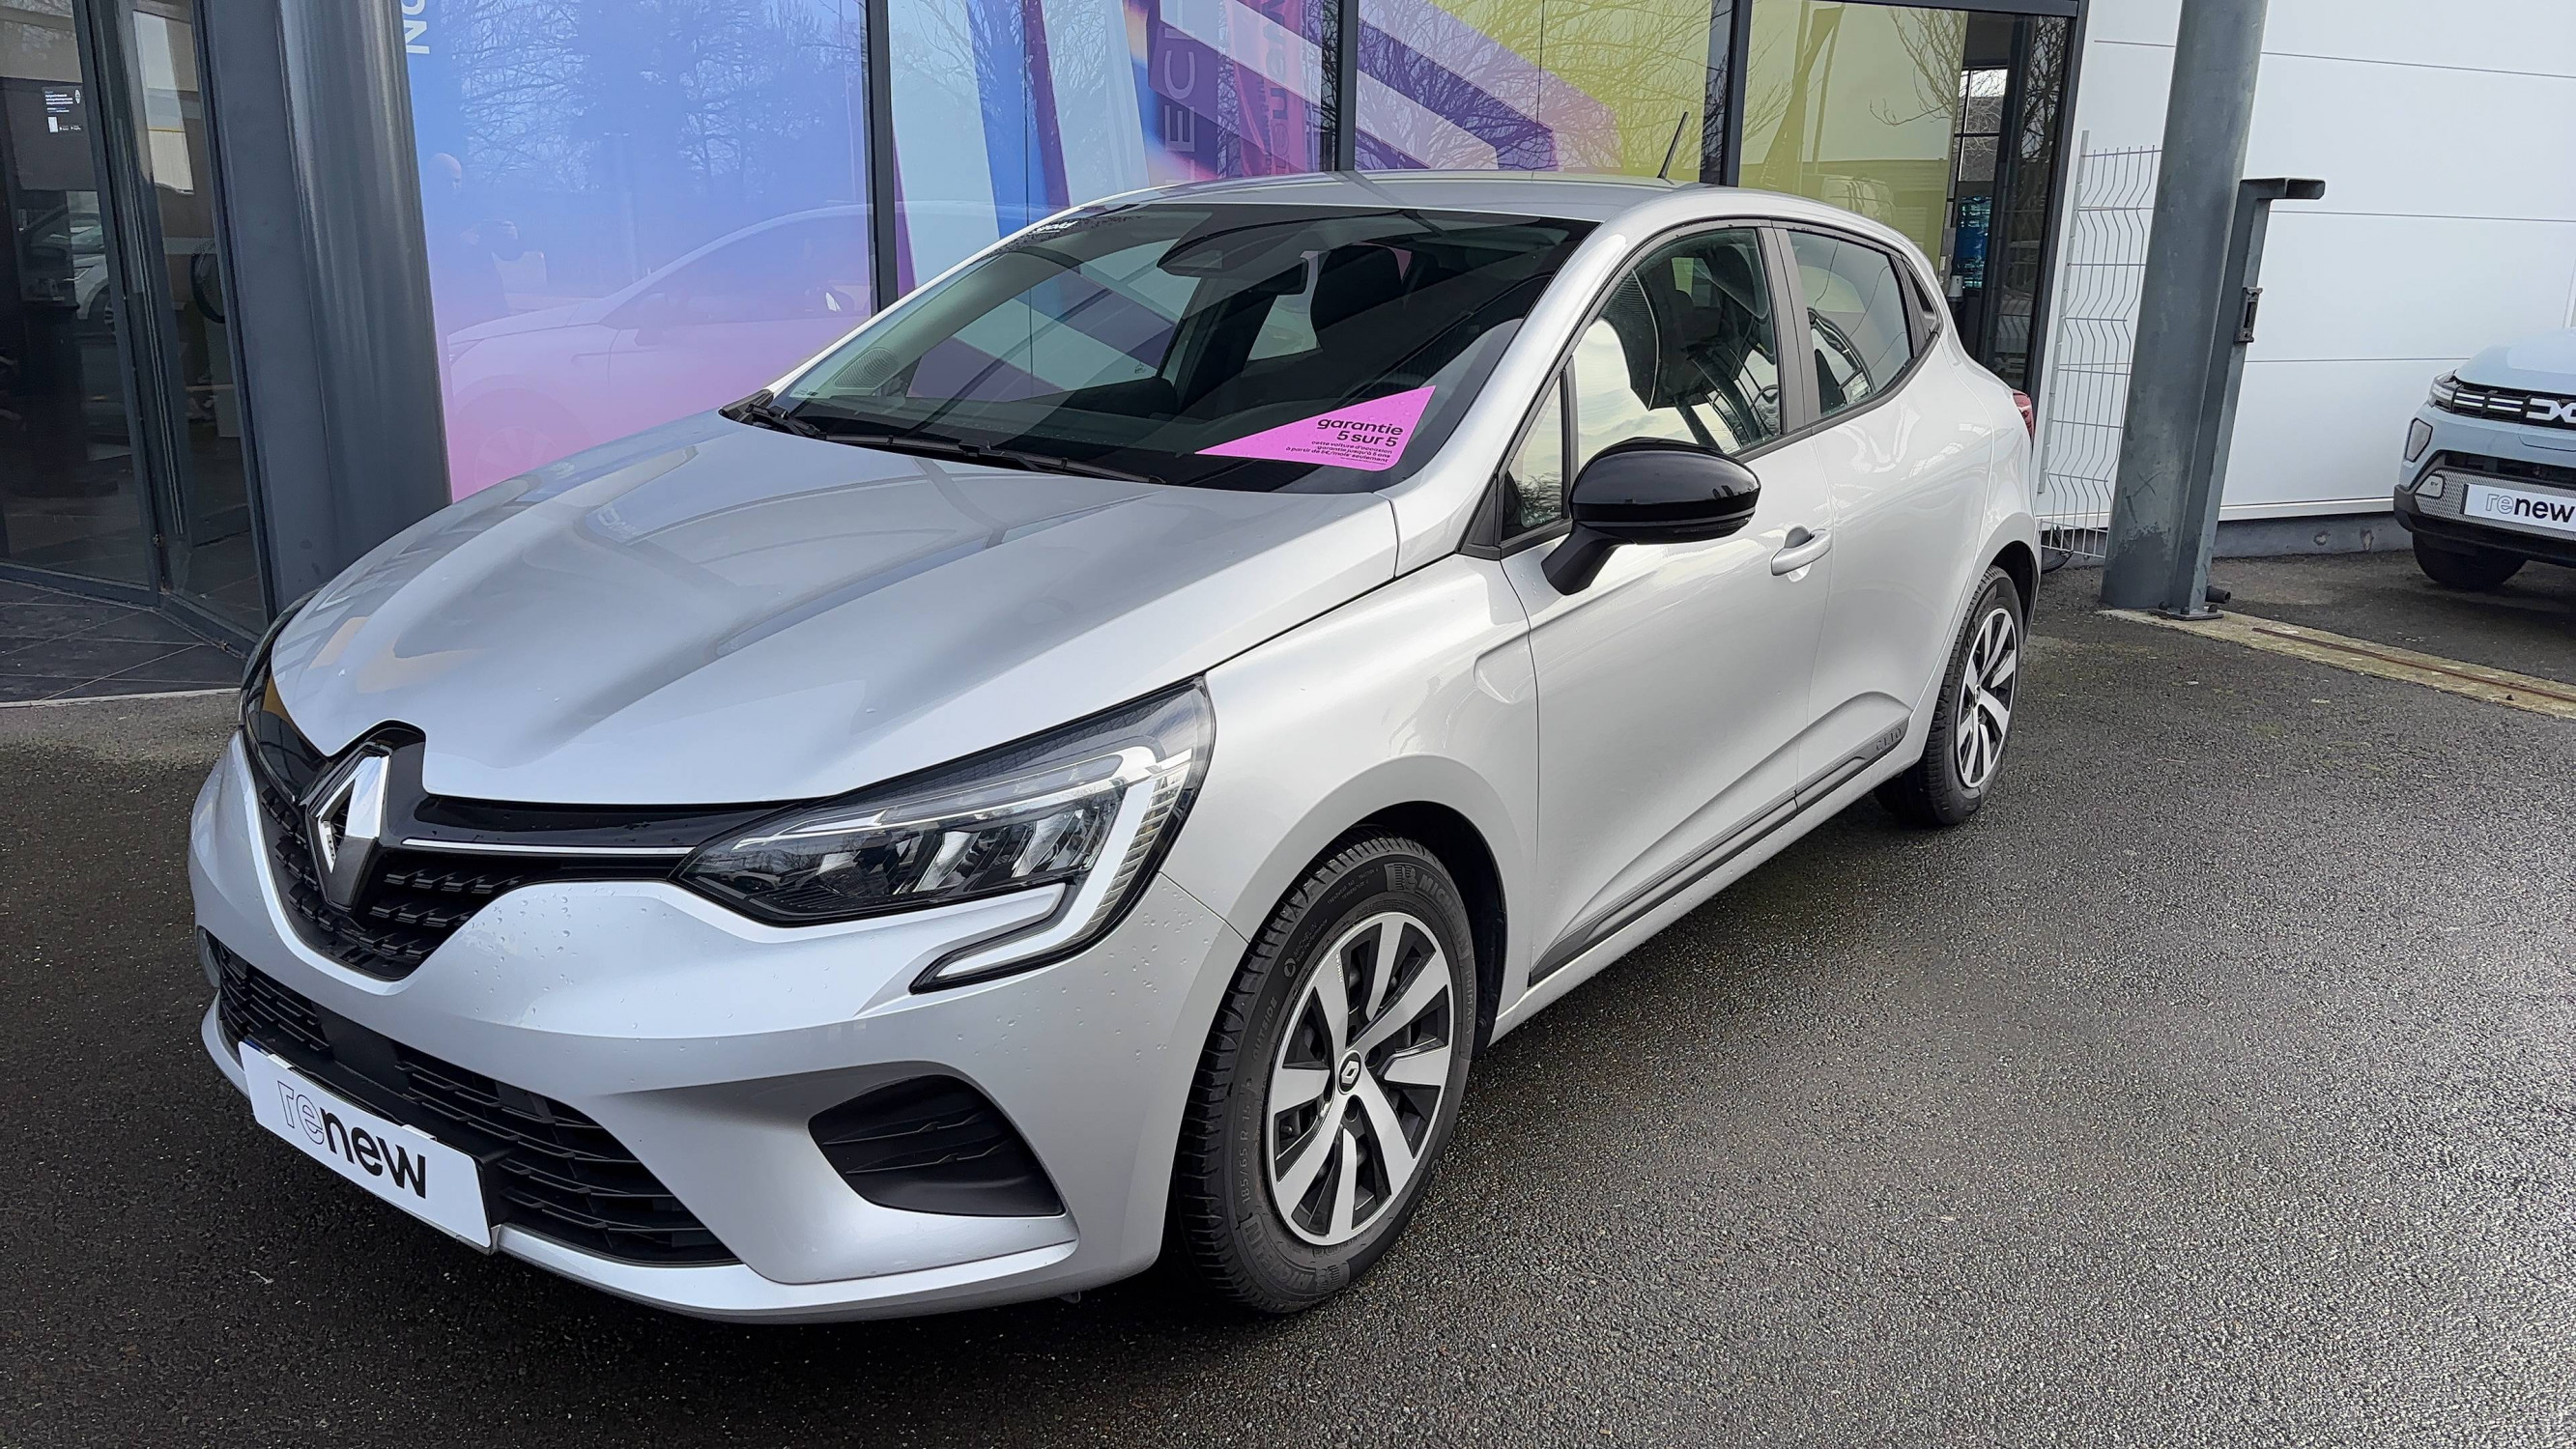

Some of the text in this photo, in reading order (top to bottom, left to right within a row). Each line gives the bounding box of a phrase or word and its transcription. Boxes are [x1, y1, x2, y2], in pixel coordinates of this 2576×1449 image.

[1316, 418, 1404, 436] garantie
[1336, 430, 1399, 447] 5 sur 5
[2485, 493, 2576, 524] renew
[1875, 727, 1902, 753] CLIO
[1465, 969, 1474, 1037] PRIMACY
[1252, 996, 1277, 1061] OUTSIDE
[276, 1079, 427, 1201] renew
[1239, 1104, 1251, 1205] 185/65 R 15
